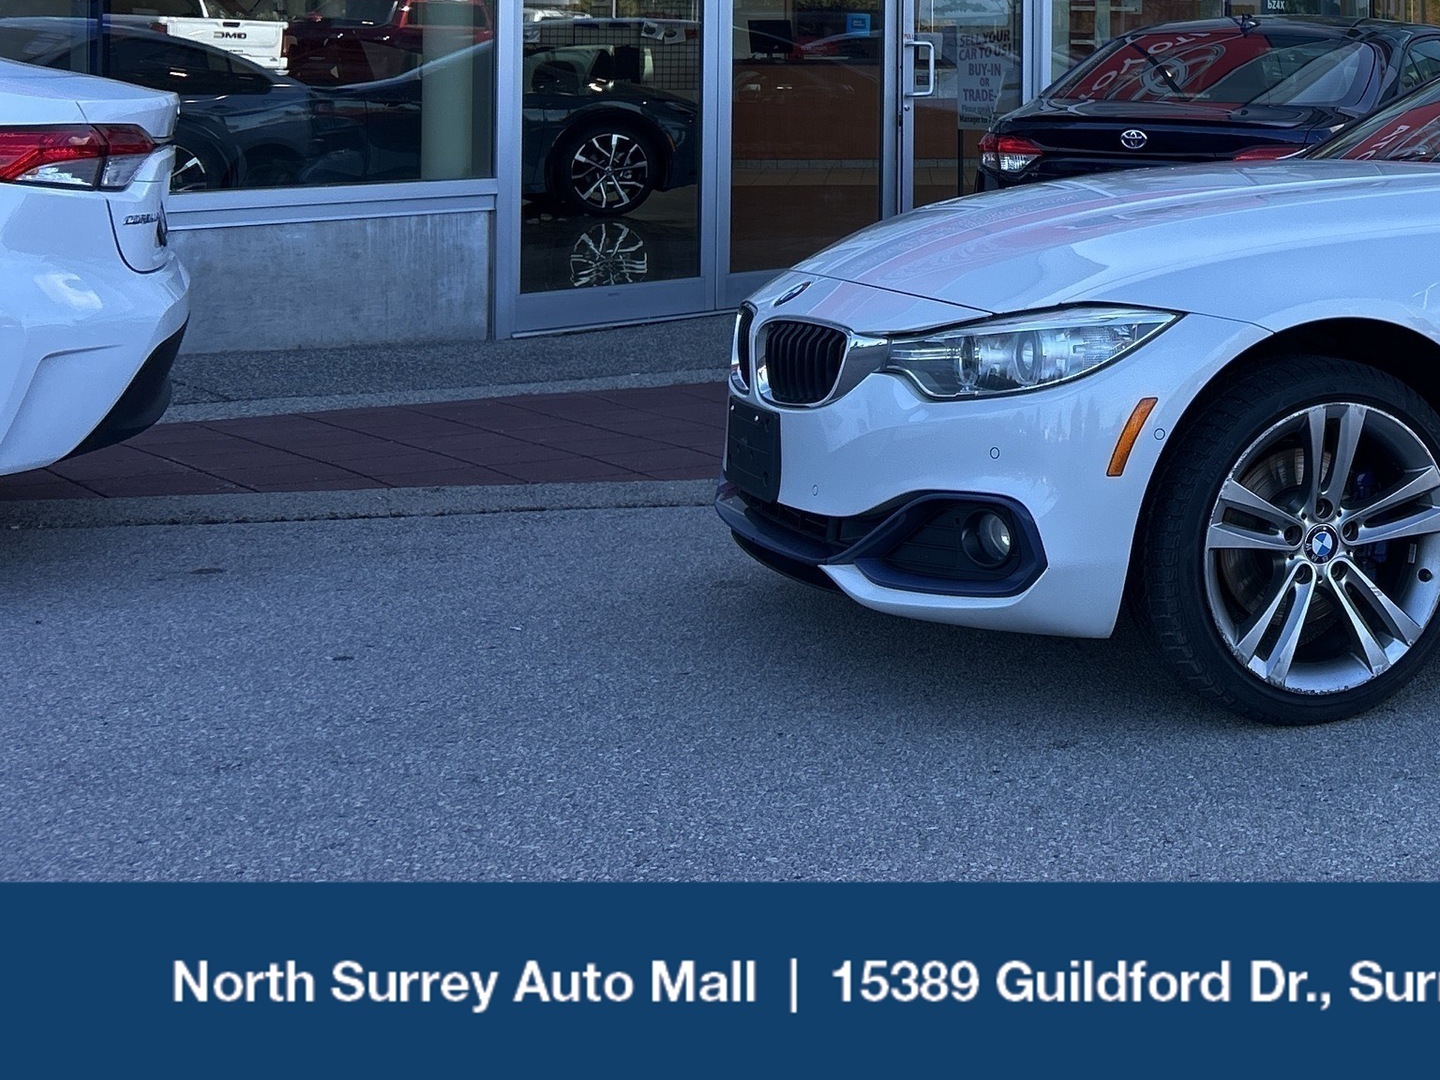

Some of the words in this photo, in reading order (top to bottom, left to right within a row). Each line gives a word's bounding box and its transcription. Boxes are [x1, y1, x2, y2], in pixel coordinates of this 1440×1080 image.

[1267, 0, 1285, 10] bZ4X
[960, 34, 981, 47] SELL
[982, 29, 1010, 43] YOUR
[959, 47, 977, 60] CAR
[978, 46, 992, 58] TO
[968, 63, 1002, 76] BUY-IN
[979, 78, 990, 87] OR
